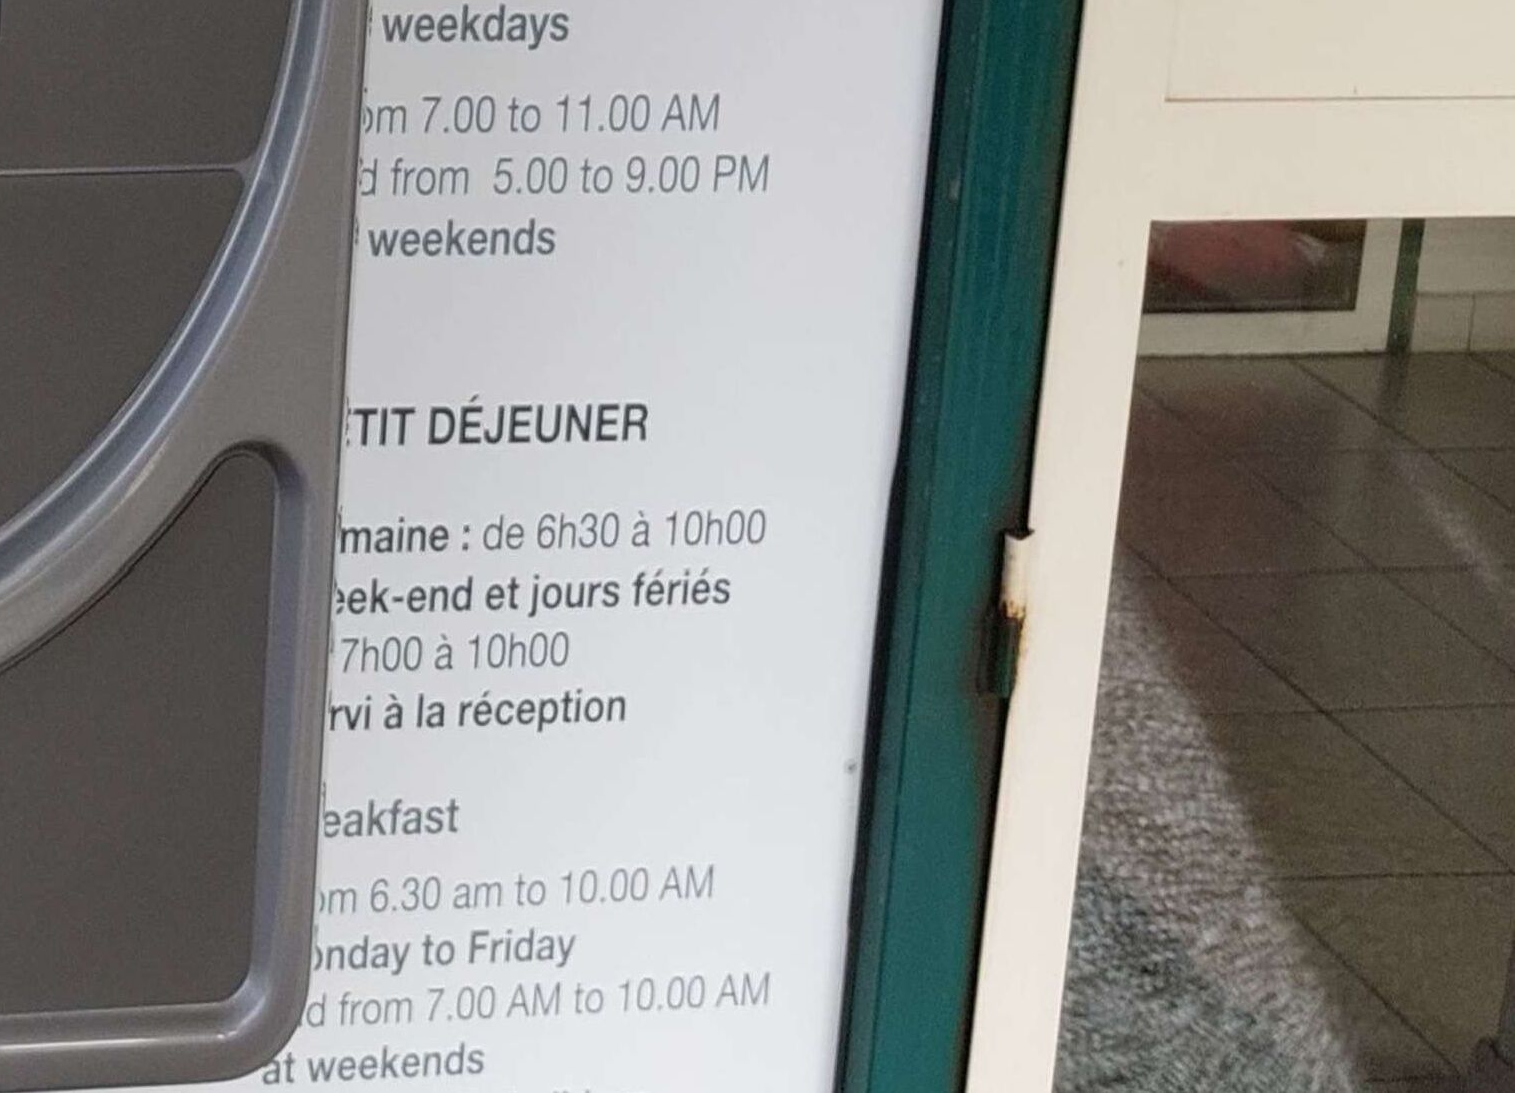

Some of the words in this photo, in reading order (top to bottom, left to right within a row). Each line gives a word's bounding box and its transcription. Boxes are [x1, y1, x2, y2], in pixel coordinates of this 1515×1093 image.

[381, 3, 569, 51] weekdays
[422, 95, 496, 134] 7.00
[507, 97, 541, 133] to
[556, 94, 651, 132] 11.00
[661, 93, 720, 132] AM
[390, 157, 469, 196] from
[493, 156, 568, 195] 5.00
[580, 158, 614, 194] to
[626, 155, 701, 194] 9.00
[713, 154, 770, 192] PM
[368, 218, 556, 257] weekends
[352, 407, 416, 447] TIT
[428, 395, 649, 445] DÉJEUNER
[338, 514, 450, 554] maine
[482, 514, 525, 551] de
[536, 512, 620, 550] 6h30
[631, 510, 650, 548] à
[666, 509, 766, 546] 10h00
[485, 576, 520, 611] et
[527, 574, 620, 618] jours
[632, 567, 731, 607] fériés
[341, 635, 423, 673] 7h00
[434, 634, 454, 671] à
[469, 631, 569, 669] 10h00
[328, 695, 372, 731] rvi
[383, 693, 404, 730] à
[416, 693, 445, 729] la
[458, 688, 626, 733] réception
[323, 796, 460, 839] eakfast
[369, 875, 442, 913] 6.30
[452, 881, 503, 910] am
[515, 874, 546, 907] to
[561, 867, 649, 904] 10.00
[659, 864, 714, 900] AM
[421, 934, 456, 967] to
[468, 928, 576, 968] Friday
[339, 991, 413, 1026] from
[427, 985, 496, 1022] 7.00
[506, 981, 561, 1018] AM
[574, 983, 604, 1014] to
[619, 974, 706, 1012] 10.00
[715, 972, 771, 1007] AM
[262, 1053, 294, 1085] at
[307, 1042, 484, 1083] weekends
